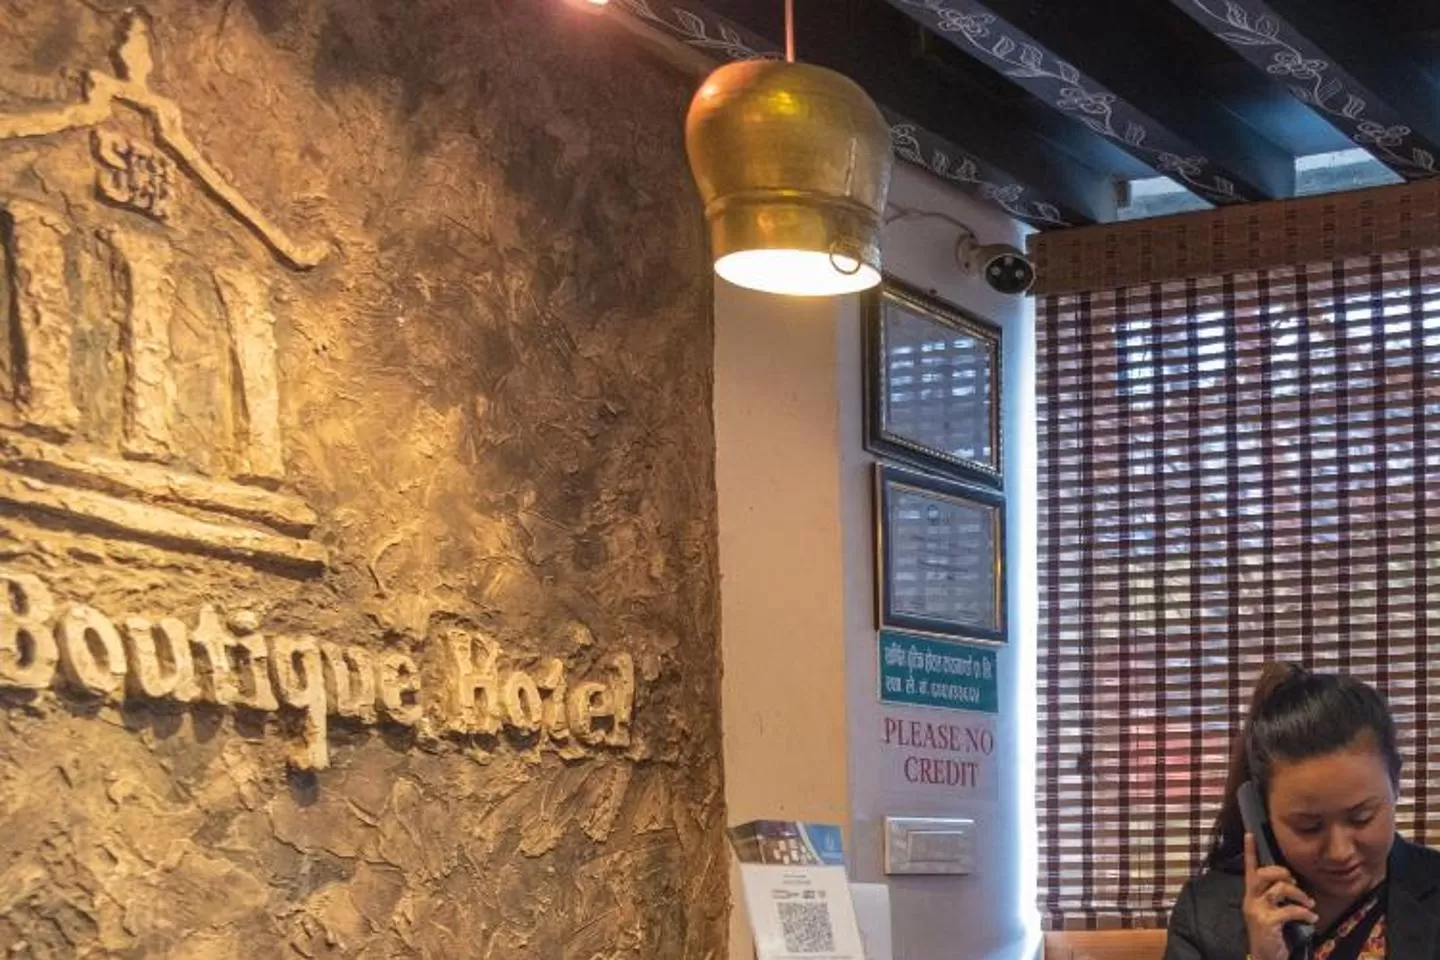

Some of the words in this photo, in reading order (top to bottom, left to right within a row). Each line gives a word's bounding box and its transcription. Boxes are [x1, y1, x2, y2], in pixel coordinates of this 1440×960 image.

[884, 717, 961, 753] PLEASE
[965, 727, 994, 755] NO
[904, 756, 979, 788] CREDIT
